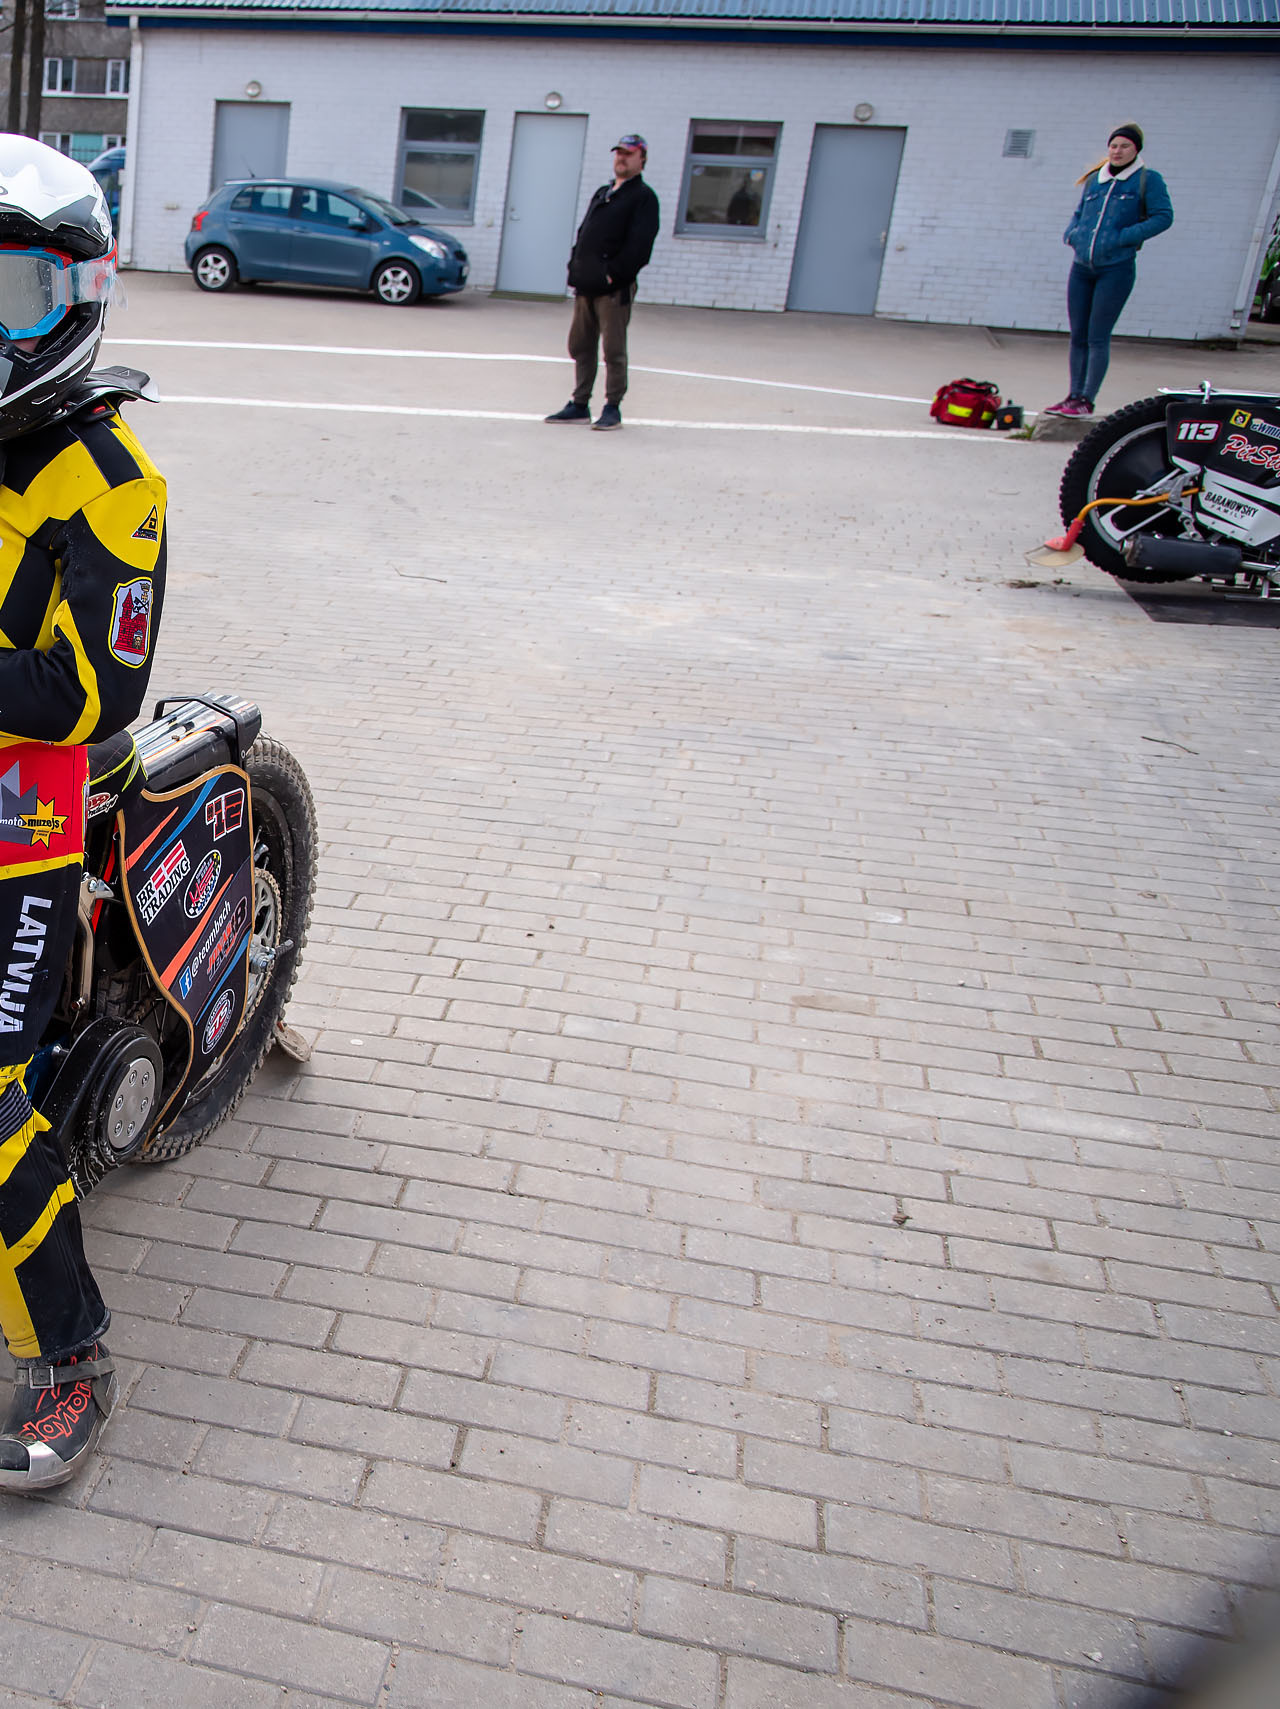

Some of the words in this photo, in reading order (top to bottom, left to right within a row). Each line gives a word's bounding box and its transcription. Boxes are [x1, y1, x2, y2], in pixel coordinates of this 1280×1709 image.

[1177, 422, 1219, 441] 113
[1220, 434, 1280, 478] PitSto
[27, 818, 60, 830] muzejs
[137, 881, 156, 911] BR
[143, 856, 189, 924] TRADING
[191, 900, 231, 978] @teambach
[18, 1380, 92, 1443] dayton
